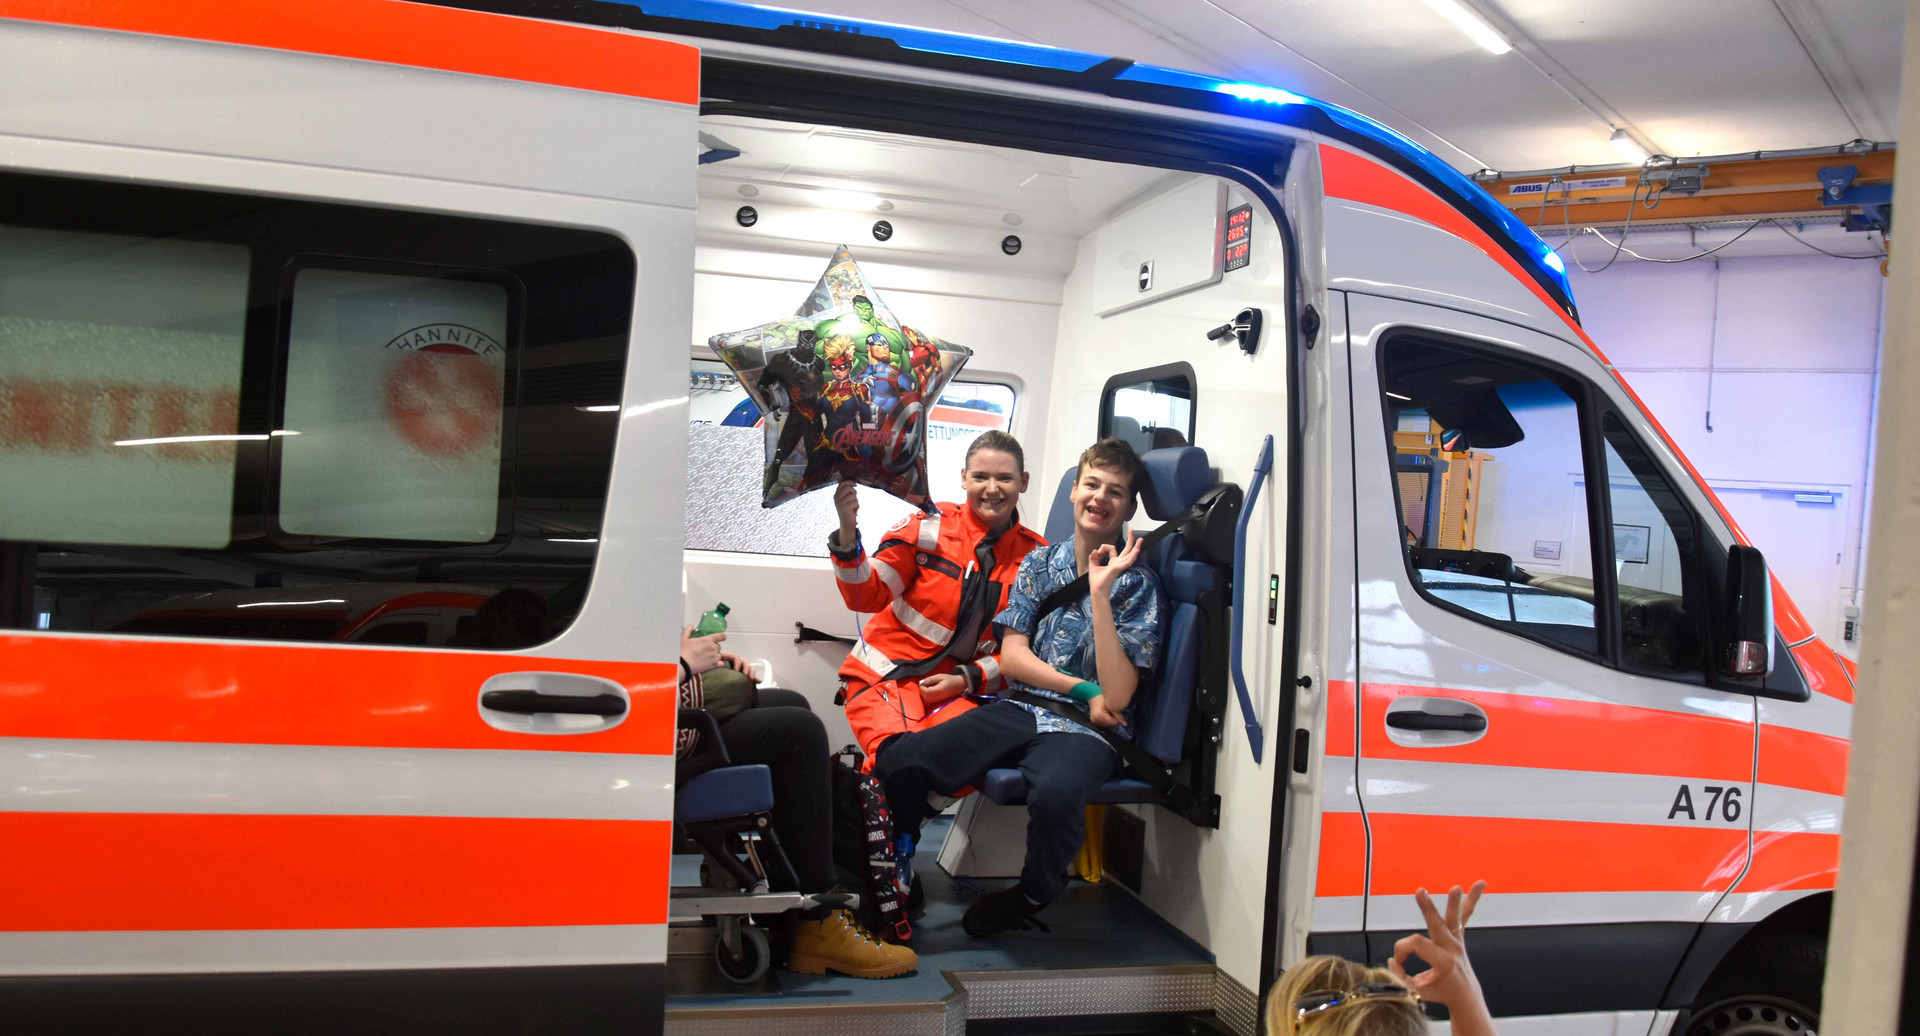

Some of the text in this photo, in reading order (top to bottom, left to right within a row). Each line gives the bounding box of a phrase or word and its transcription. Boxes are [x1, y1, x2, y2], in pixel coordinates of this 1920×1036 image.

[1512, 184, 1543, 194] ABUS
[832, 423, 896, 451] AVENGERS
[1667, 784, 1742, 823] A 76
